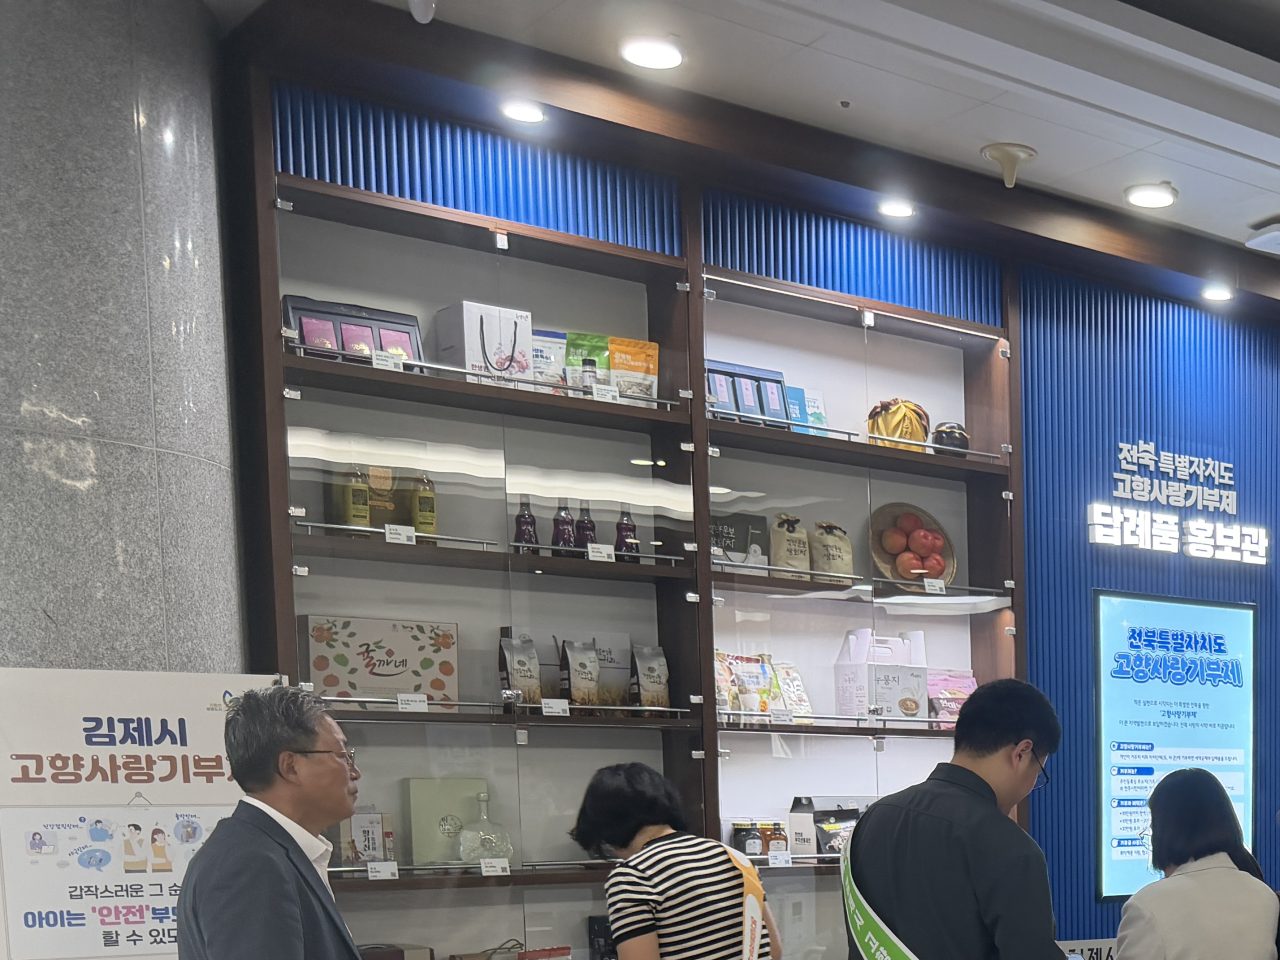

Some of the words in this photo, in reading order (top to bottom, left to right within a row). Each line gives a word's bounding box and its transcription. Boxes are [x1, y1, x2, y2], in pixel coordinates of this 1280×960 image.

[1112, 472, 1237, 515] 고향사랑기부제
[1088, 503, 1180, 554] 답례품
[1182, 518, 1268, 566] 홍보관
[1128, 626, 1227, 655] 전북특별자치도
[1111, 652, 1243, 688] 고향사랑기부제
[82, 716, 188, 748] 김제시
[10, 754, 237, 783] 고향사랑기부
[68, 884, 144, 899] 갑작스러운
[149, 883, 163, 897] 그
[168, 882, 182, 897] 순
[24, 910, 86, 928] 아이는
[102, 931, 120, 946] 할
[126, 930, 143, 946] 수
